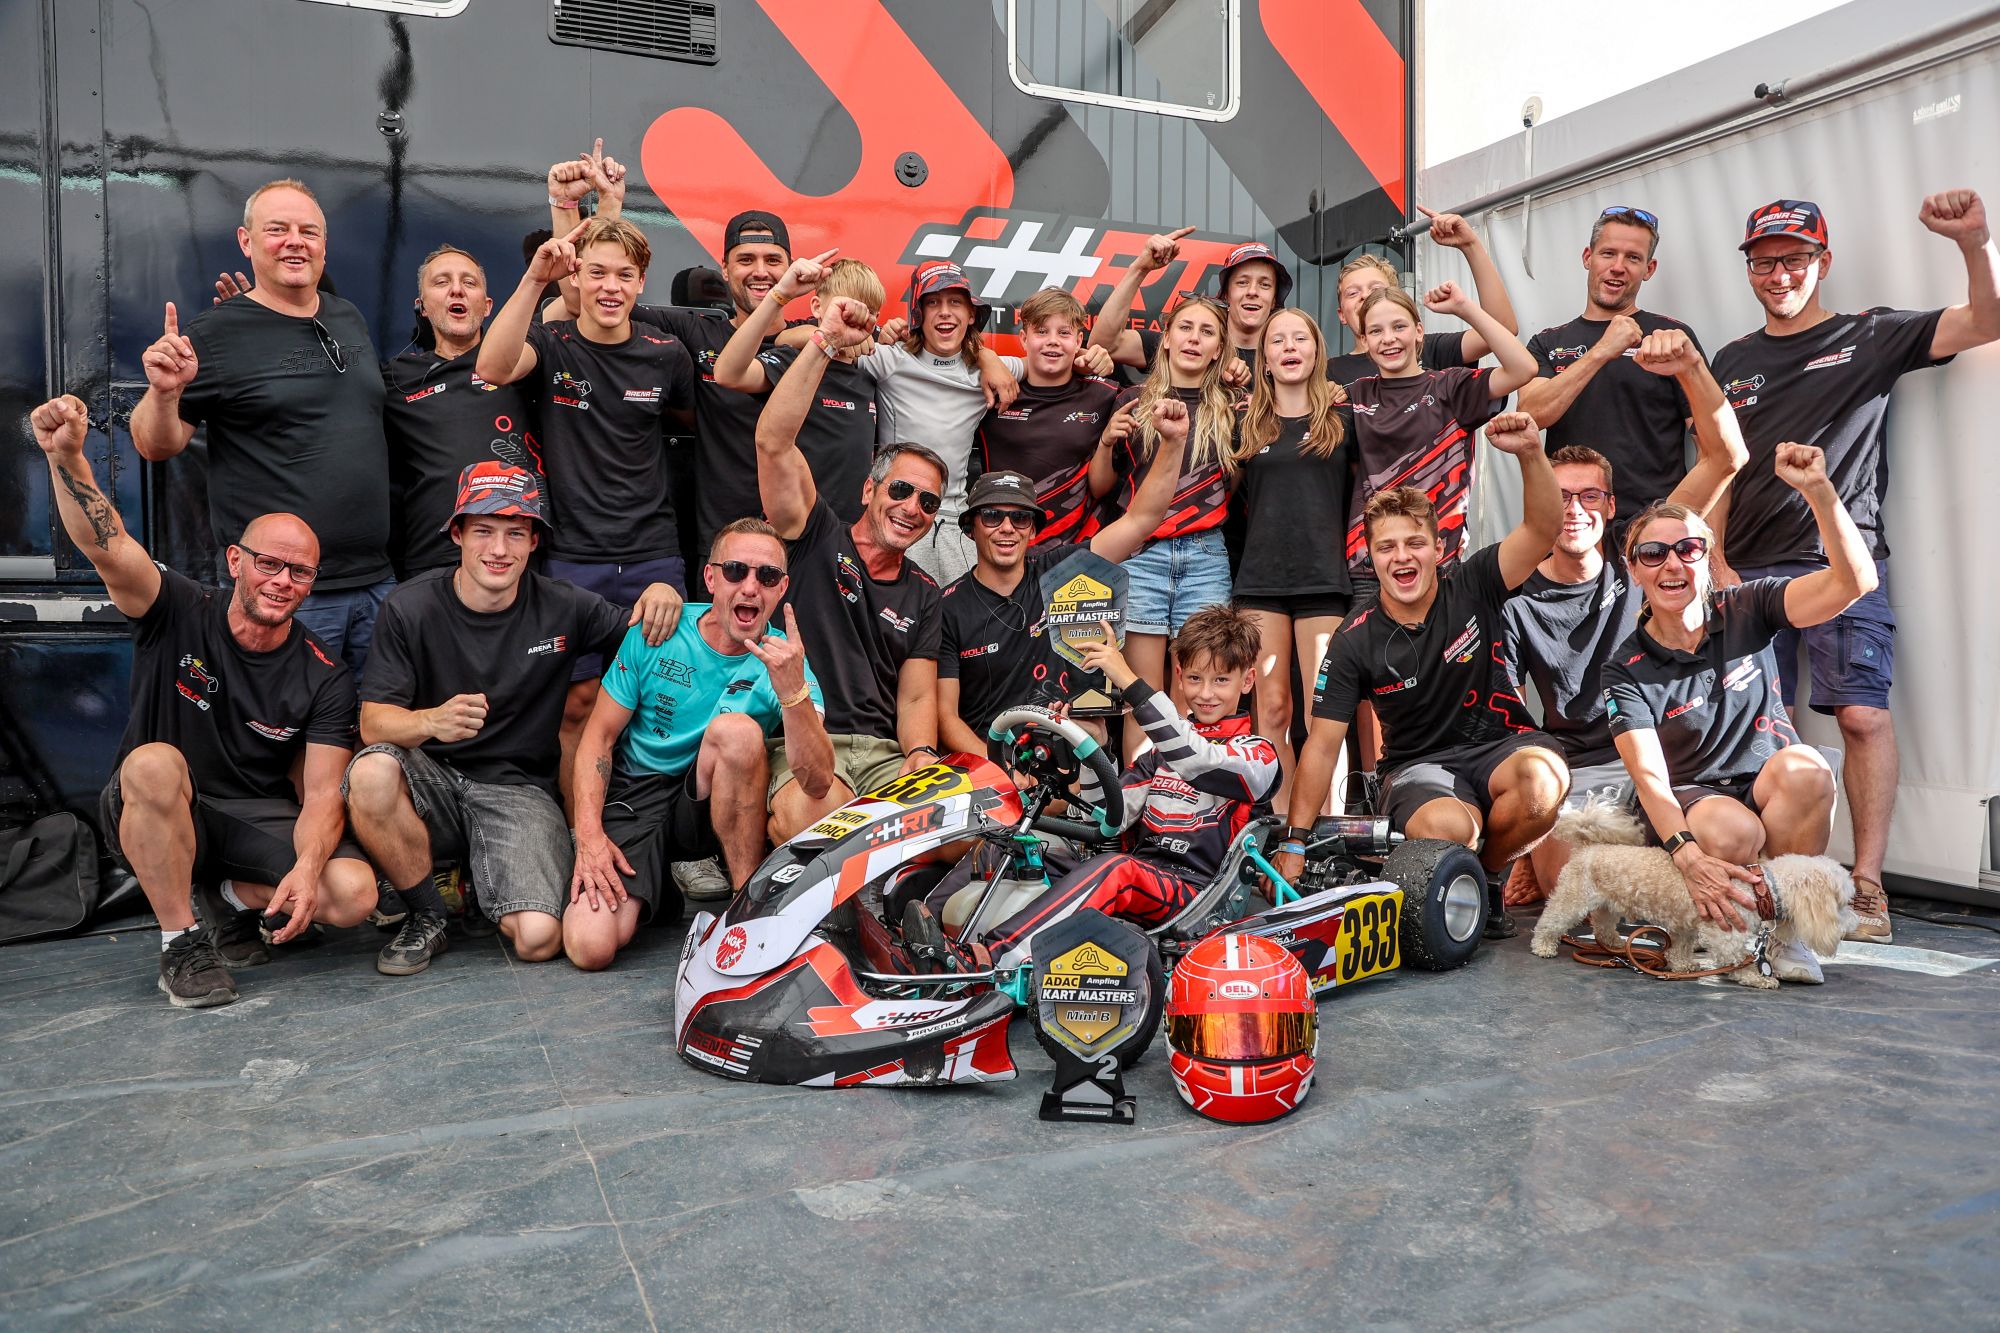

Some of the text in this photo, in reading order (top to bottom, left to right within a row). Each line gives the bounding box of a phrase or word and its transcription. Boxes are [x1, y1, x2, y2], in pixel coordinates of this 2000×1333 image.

[963, 221, 1235, 313] HRT
[405, 386, 434, 402] WOLF
[553, 396, 579, 406] WOLF
[823, 399, 846, 408] WOLF
[1050, 603, 1076, 613] ADAC
[1049, 611, 1120, 624] KART MASTERS
[1068, 628, 1102, 638] Mini A
[527, 643, 552, 655] ARENA
[176, 680, 201, 702] WOLF
[1373, 681, 1404, 695] WOLF
[1666, 700, 1694, 718] WOLF
[1151, 776, 1193, 793] RENA
[809, 822, 847, 838] ADAC
[877, 806, 934, 842] HRT
[1277, 928, 1292, 936] LION
[1342, 898, 1397, 980] 333
[724, 934, 743, 949] NGK
[1044, 976, 1120, 987] ADAC Ampfing
[1042, 989, 1136, 1003] KART MASTERS
[1225, 985, 1253, 993] BELL
[1066, 1011, 1111, 1022] Mini B
[912, 1015, 965, 1036] RAVENOL
[1095, 1054, 1118, 1080] 2
